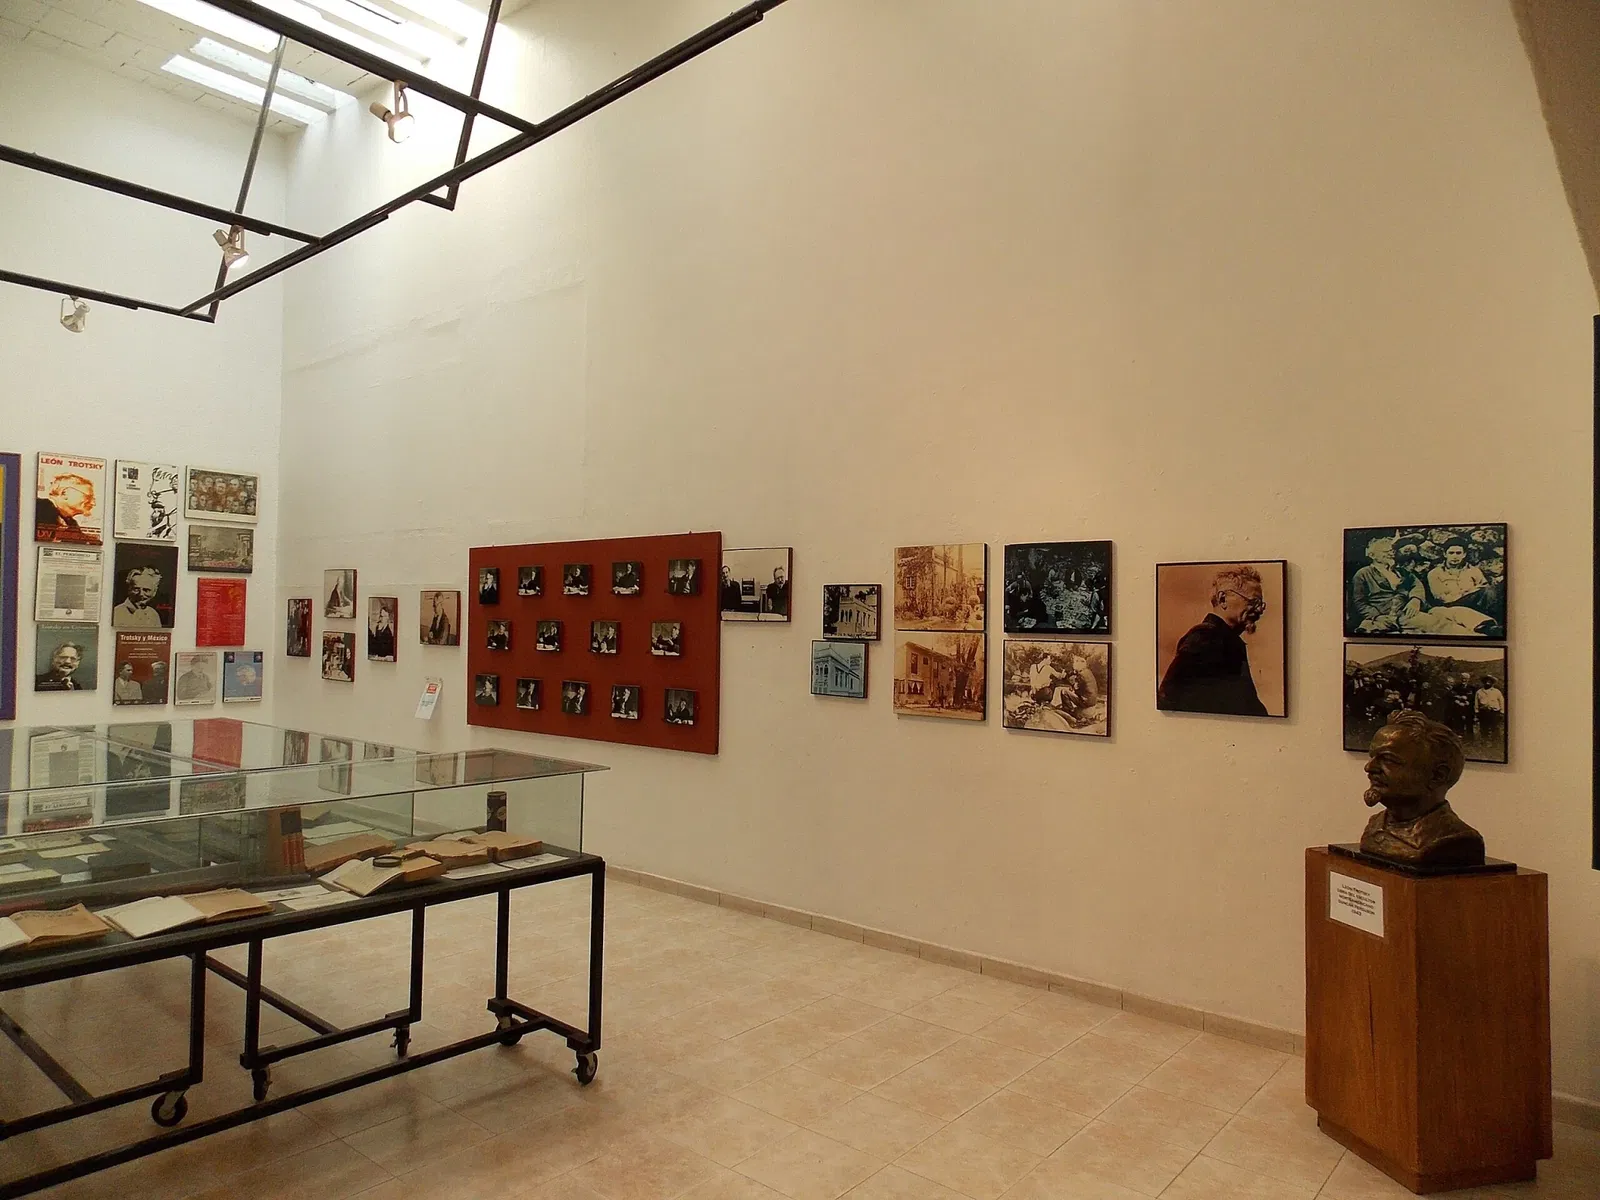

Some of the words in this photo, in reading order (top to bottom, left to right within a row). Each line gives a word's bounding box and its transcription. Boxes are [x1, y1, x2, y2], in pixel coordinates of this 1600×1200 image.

[40, 457, 63, 466] LEÓN
[68, 461, 104, 470] TROTSKY
[120, 634, 141, 642] Trotsky
